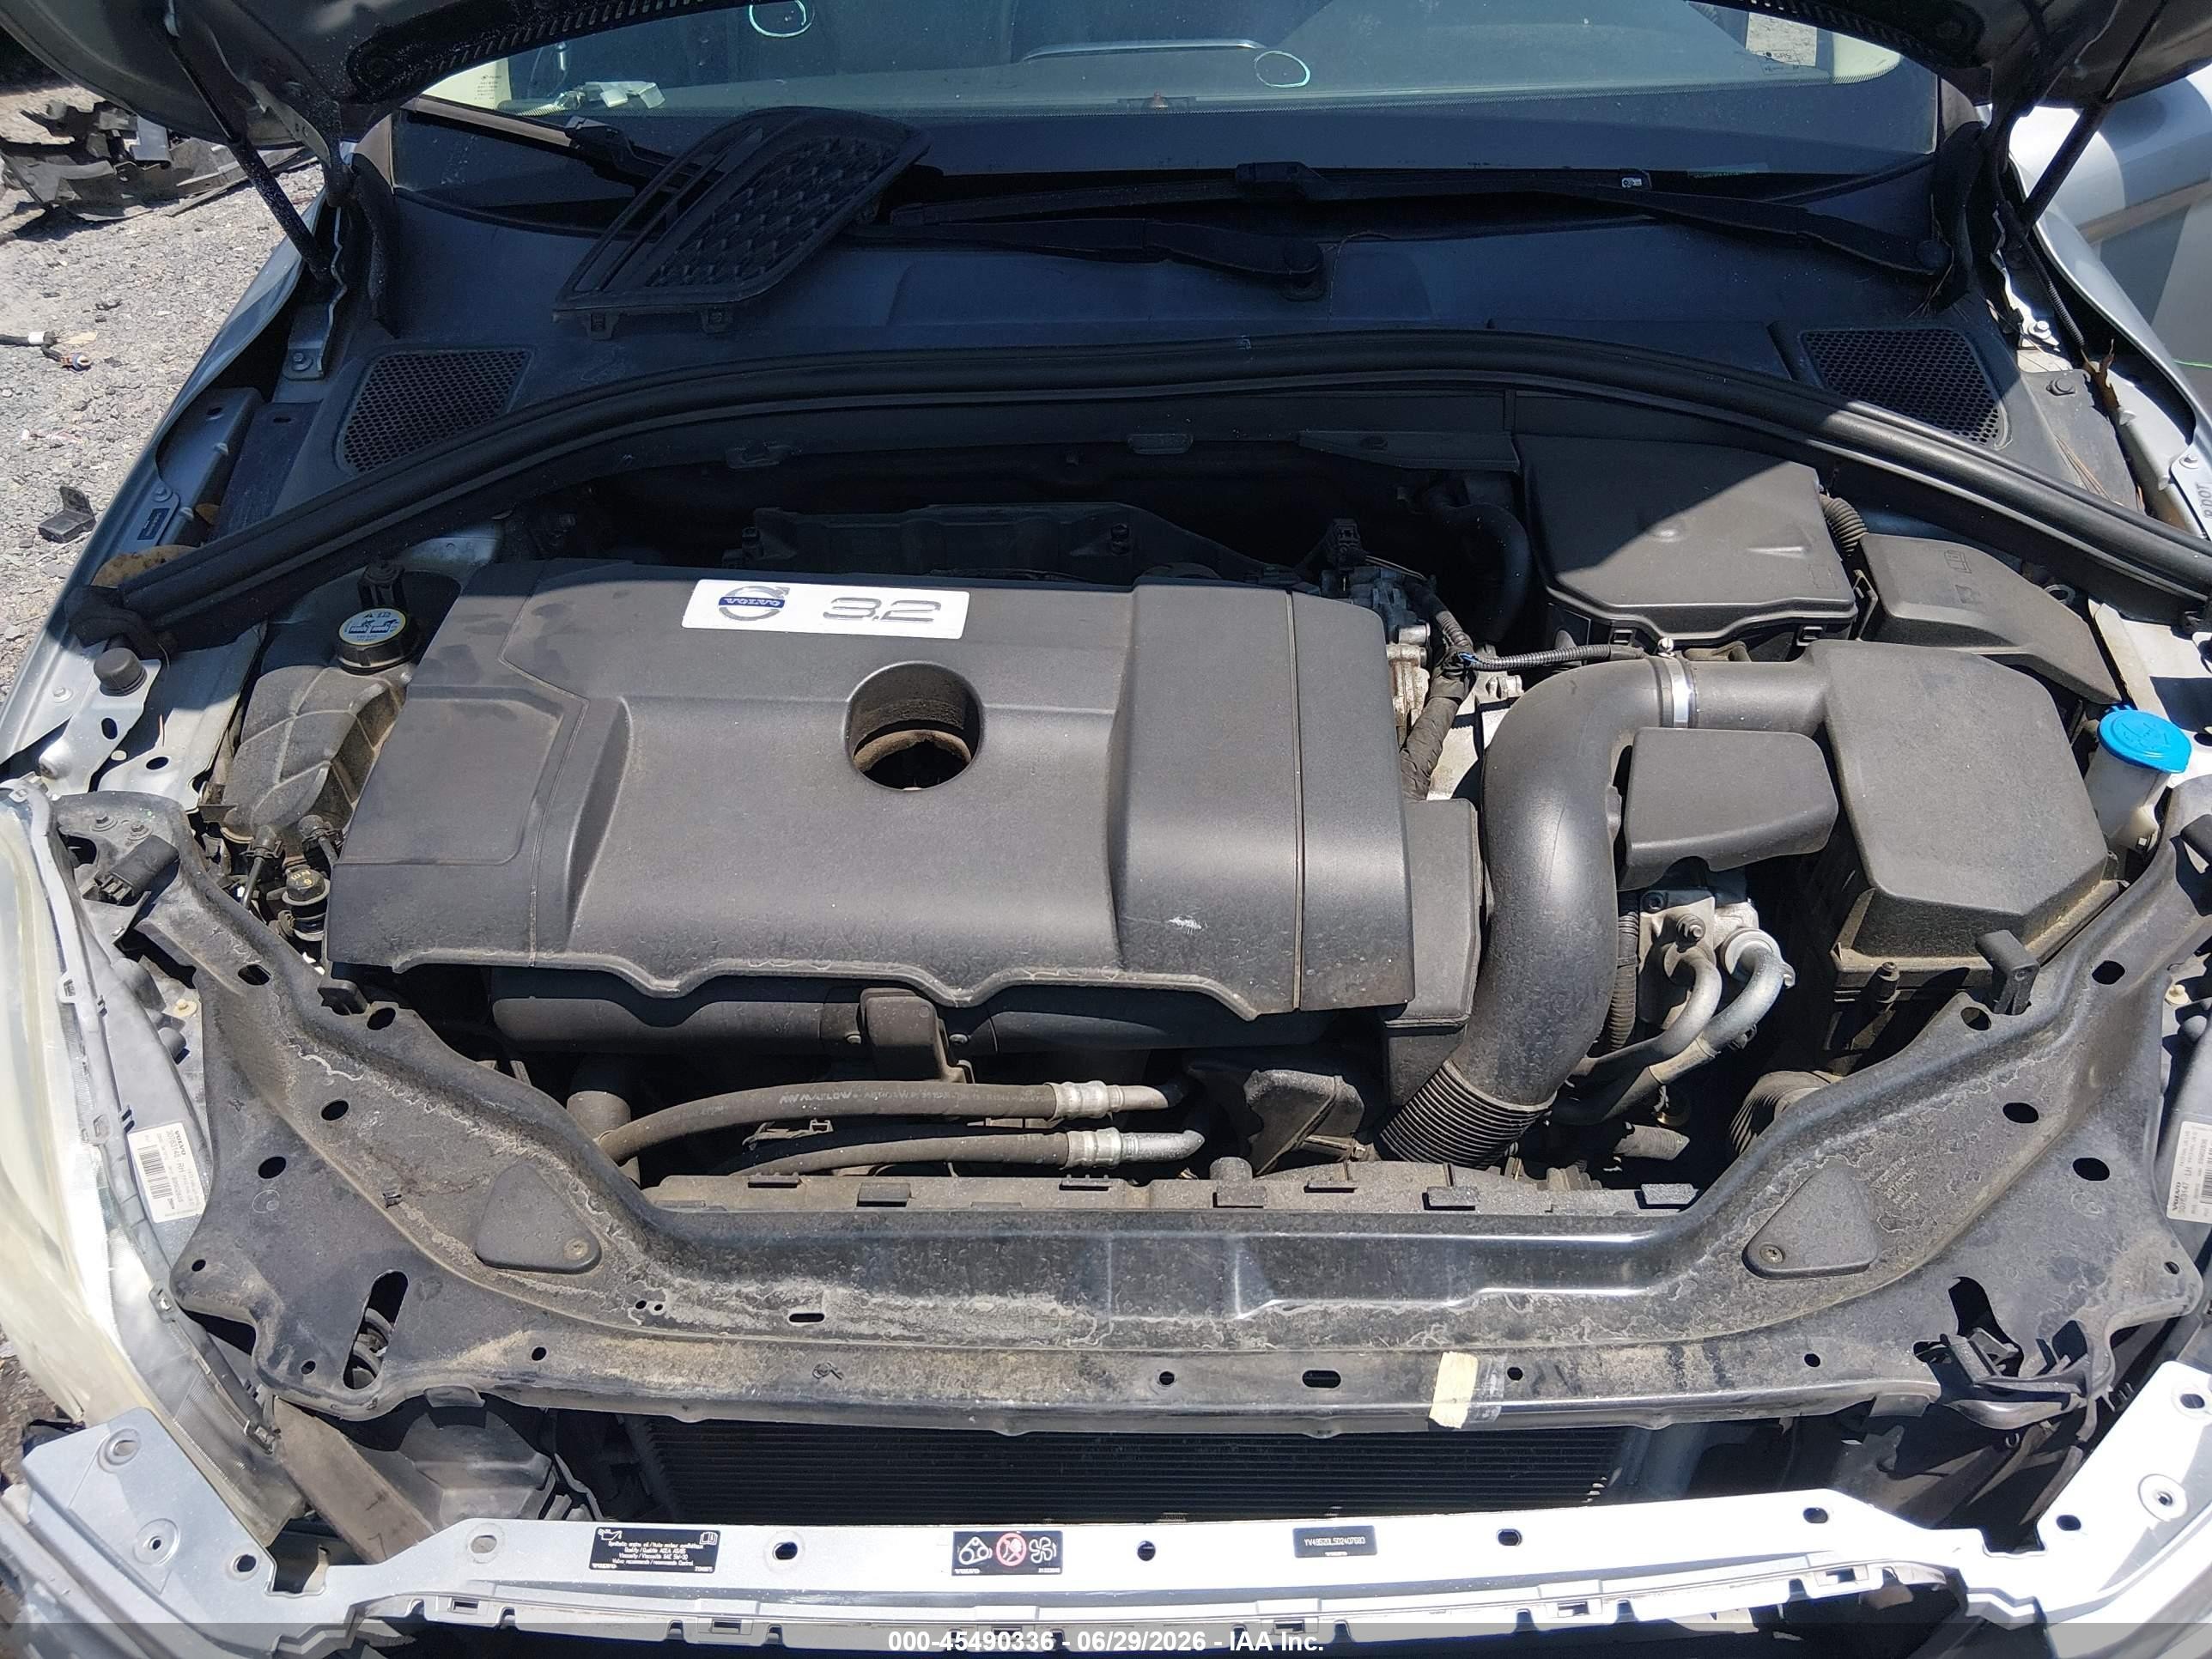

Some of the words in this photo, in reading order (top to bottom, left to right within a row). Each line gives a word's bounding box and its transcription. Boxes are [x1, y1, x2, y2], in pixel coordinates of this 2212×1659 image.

[725, 597, 781, 607] VOLVO
[823, 597, 942, 623] 3.2
[175, 1130, 186, 1156] VOLVO
[177, 1163, 185, 1173] RH
[2172, 1182, 2182, 1211] VOLVO
